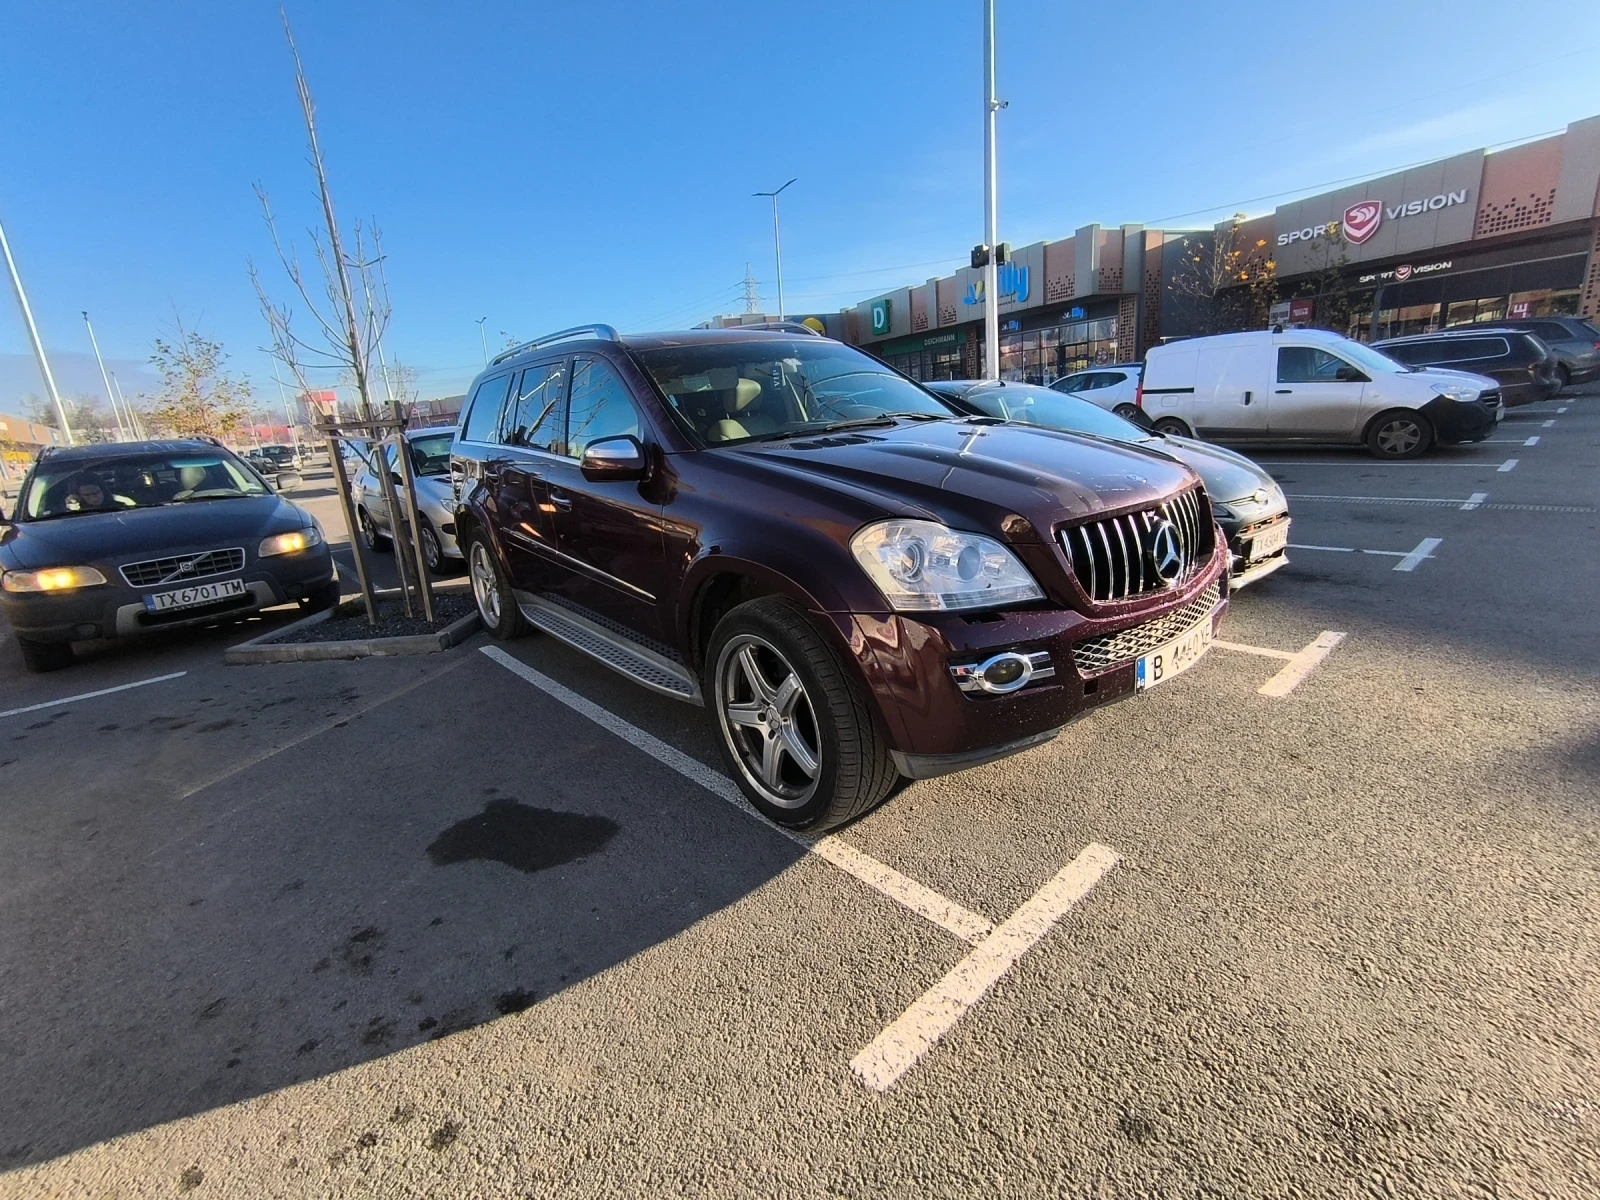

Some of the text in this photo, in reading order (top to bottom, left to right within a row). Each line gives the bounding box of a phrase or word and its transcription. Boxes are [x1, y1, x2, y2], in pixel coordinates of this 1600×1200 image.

[1385, 188, 1468, 220] VISION
[1412, 260, 1453, 275] VISION
[873, 306, 885, 329] D
[923, 333, 956, 347] DEICHMANN
[156, 591, 179, 608] TX
[181, 585, 219, 604] 6701
[220, 580, 243, 595] TM
[1153, 654, 1164, 682] B
